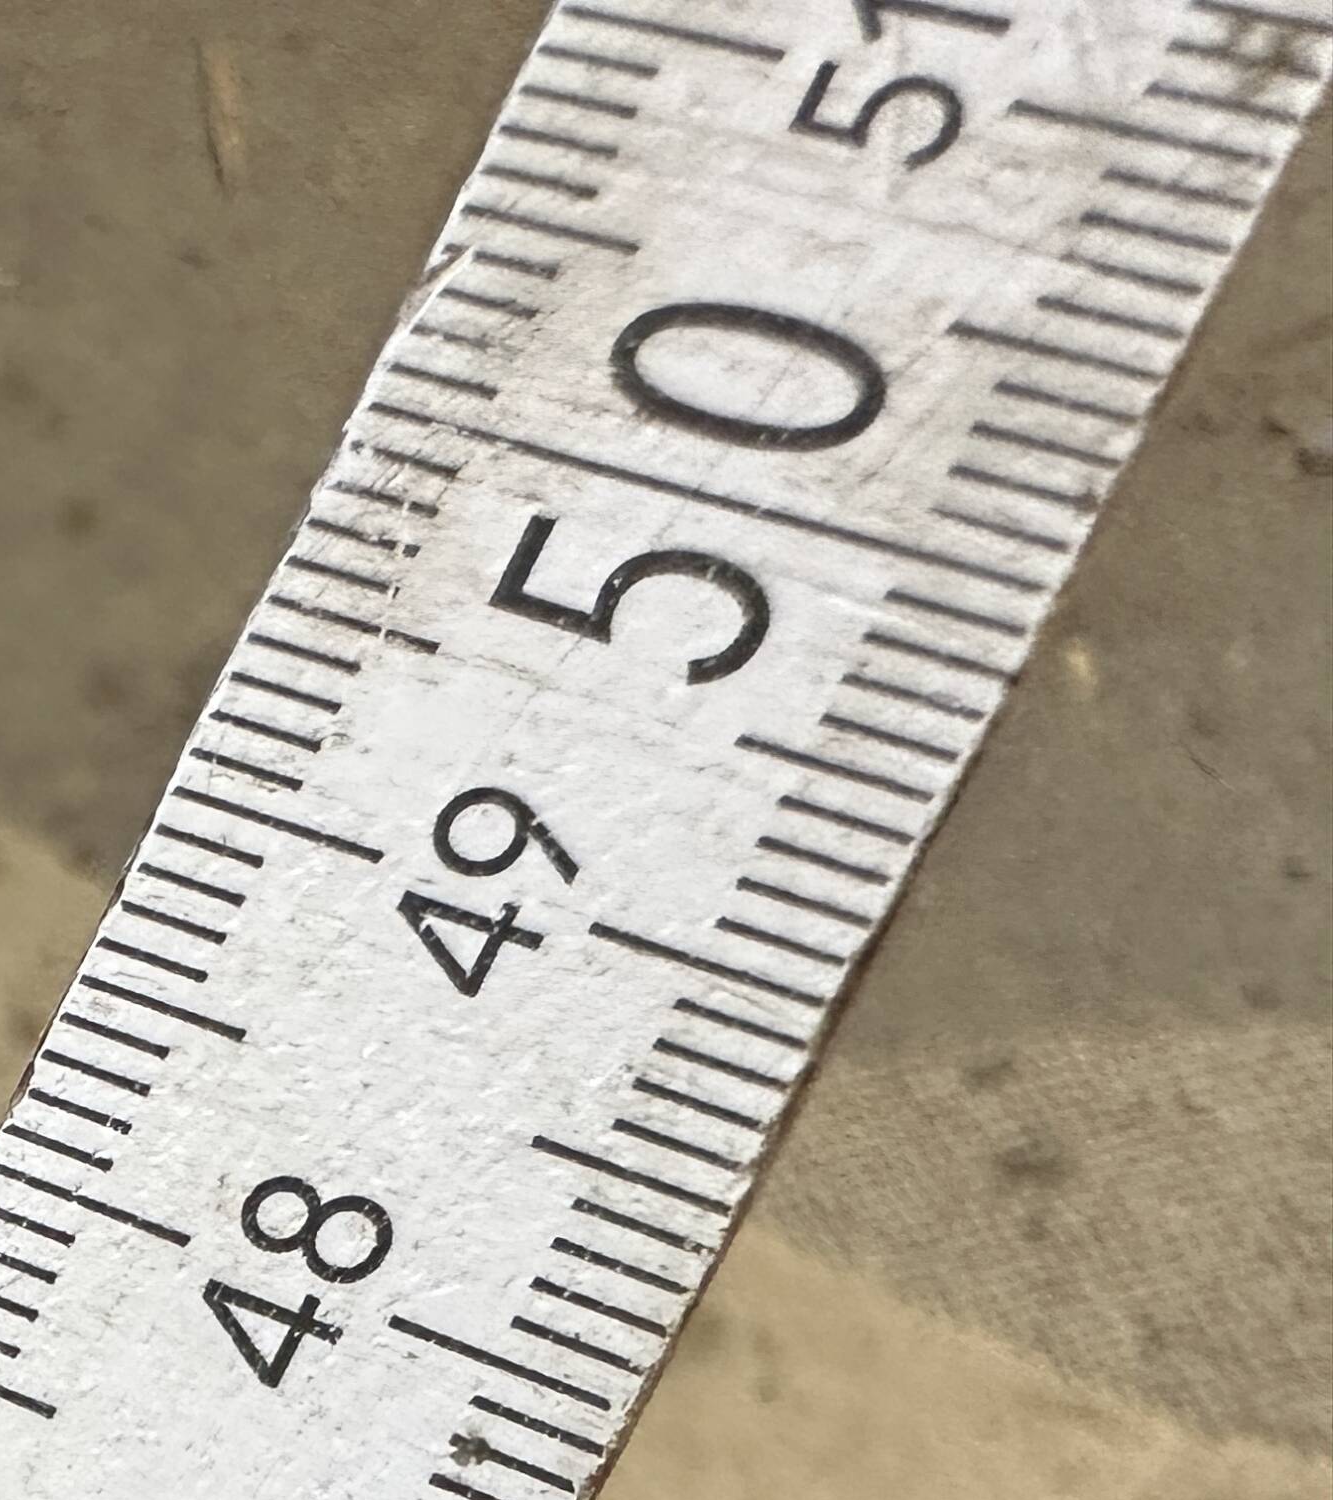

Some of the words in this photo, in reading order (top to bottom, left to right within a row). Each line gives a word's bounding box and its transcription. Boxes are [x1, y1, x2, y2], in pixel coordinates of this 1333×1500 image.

[788, 0, 1011, 171] 51
[489, 302, 888, 687] 50
[396, 786, 580, 998] 49
[201, 1175, 394, 1389] 48
